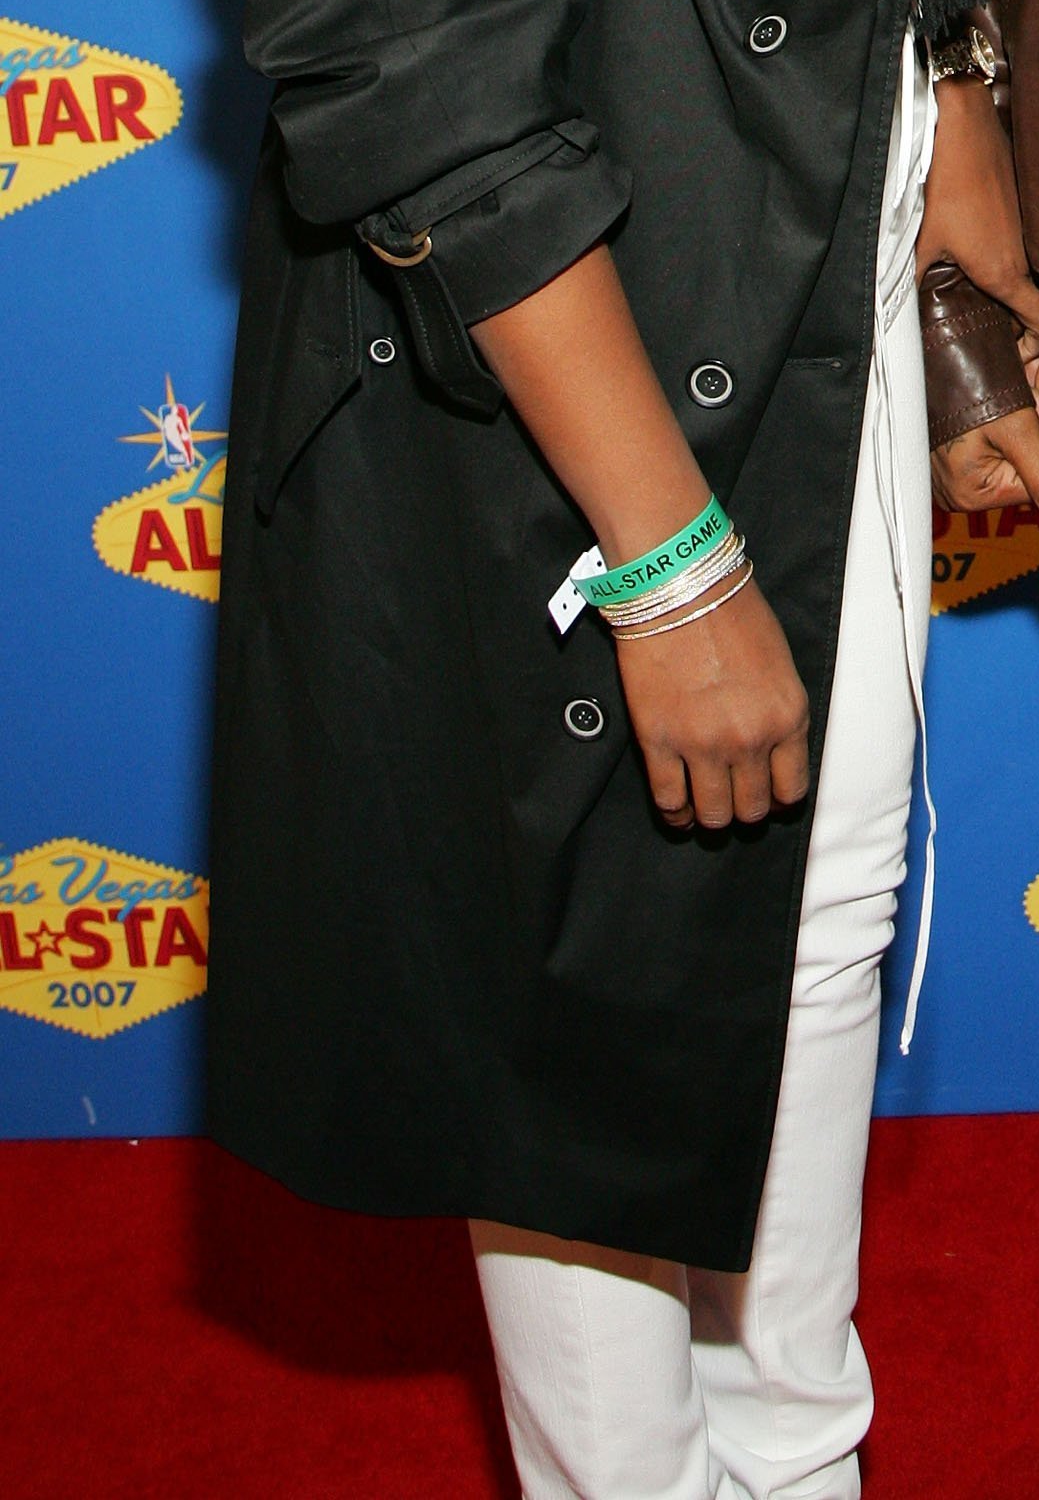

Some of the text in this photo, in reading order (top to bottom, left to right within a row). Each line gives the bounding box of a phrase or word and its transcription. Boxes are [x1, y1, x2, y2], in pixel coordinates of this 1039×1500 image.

[589, 512, 722, 600] ALL-STAR GAME
[51, 856, 200, 923] Vegas
[48, 980, 137, 1008] 2007
